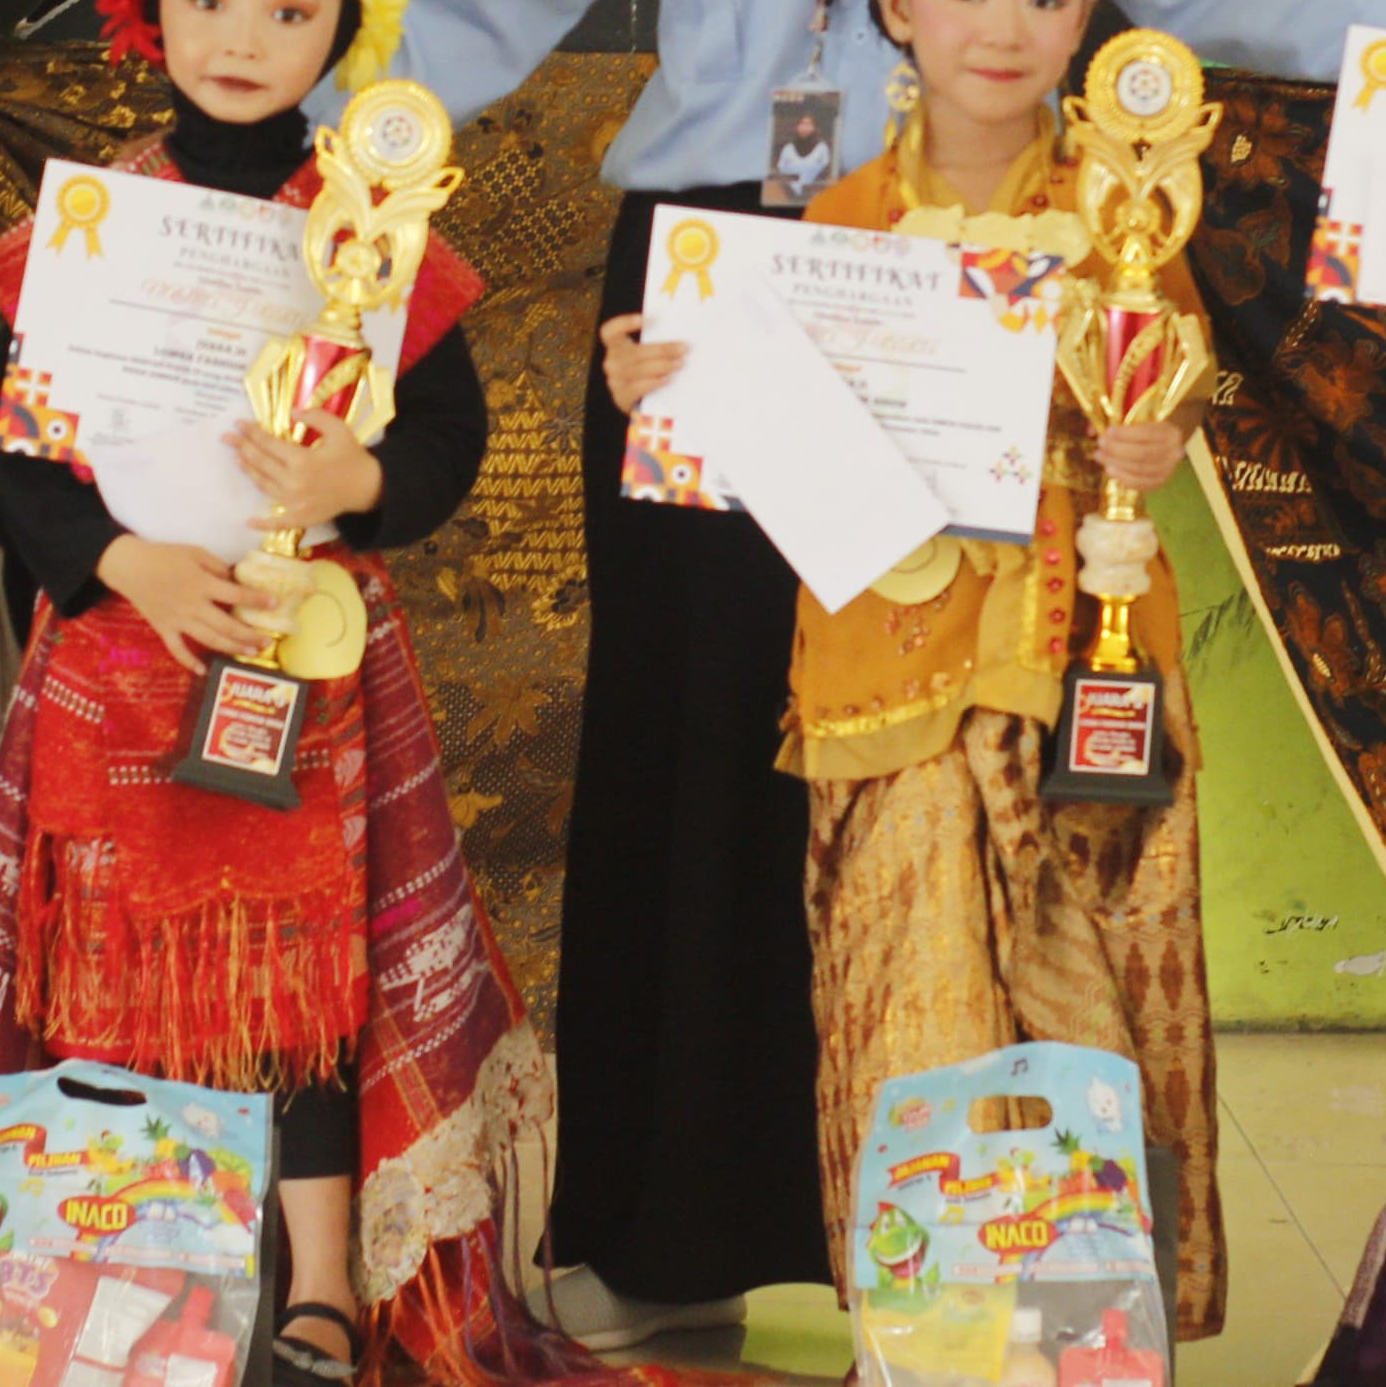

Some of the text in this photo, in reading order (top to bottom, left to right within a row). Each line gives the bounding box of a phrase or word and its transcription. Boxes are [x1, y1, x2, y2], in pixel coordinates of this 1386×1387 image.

[161, 214, 303, 262] SERTIFIKA
[773, 253, 941, 291] SERTIFIKAT
[66, 1199, 128, 1231] INACO
[985, 1221, 1048, 1249] INACO
